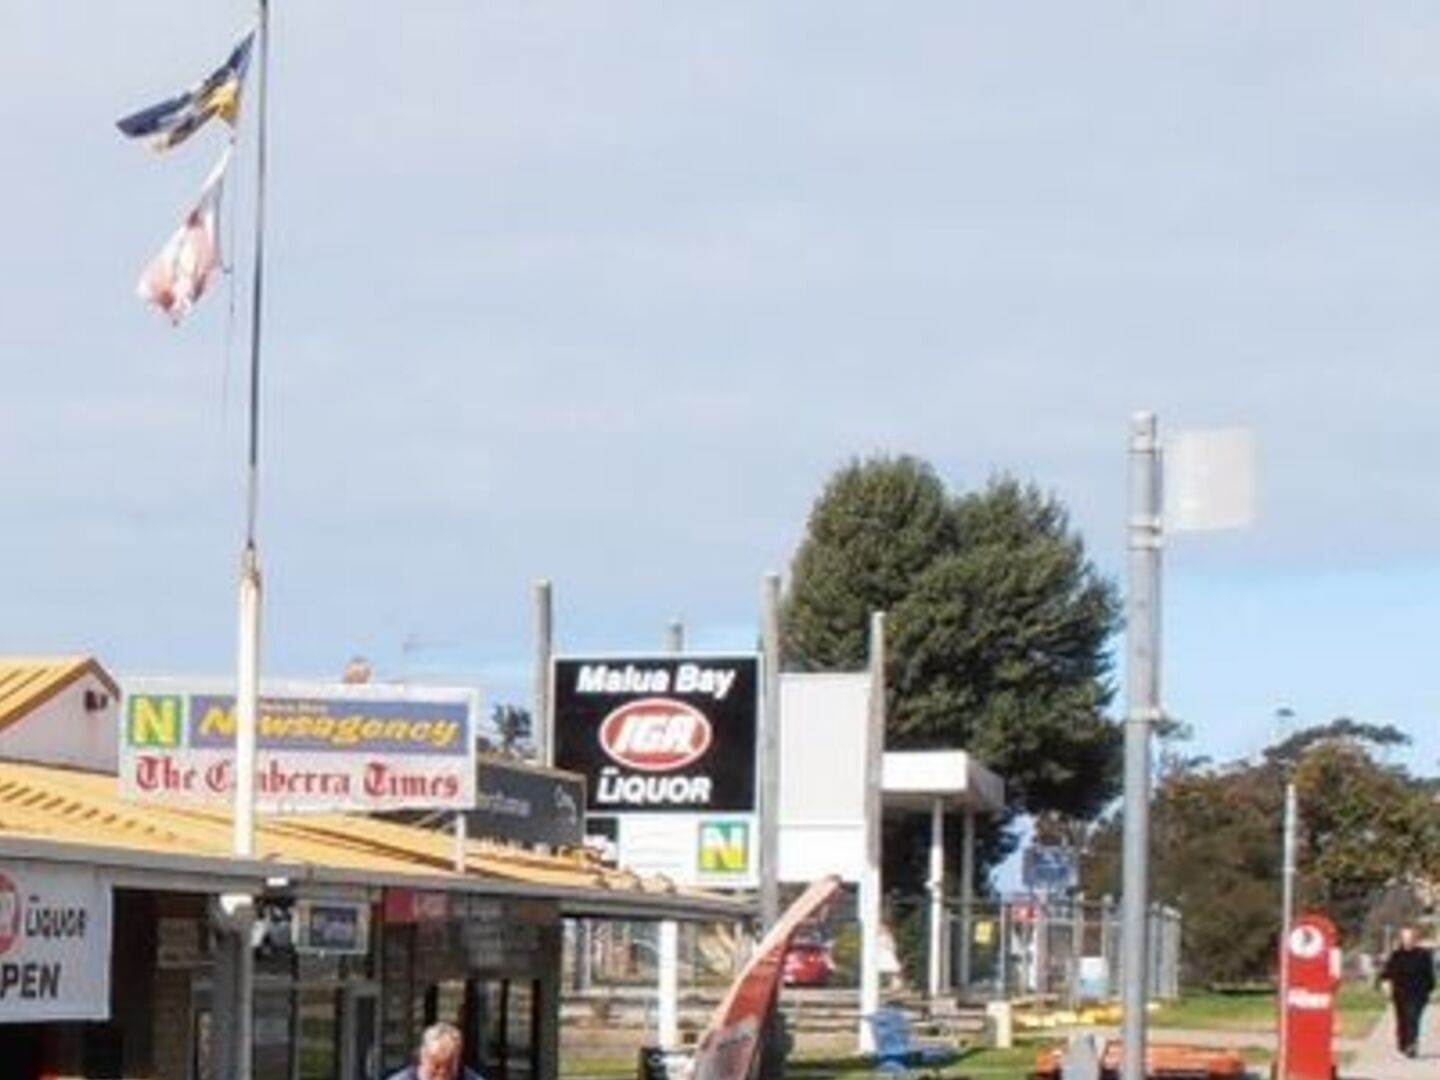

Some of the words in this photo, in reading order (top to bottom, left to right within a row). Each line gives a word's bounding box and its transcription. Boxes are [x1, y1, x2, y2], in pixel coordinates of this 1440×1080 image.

[675, 664, 736, 699] Bay
[132, 697, 177, 745] N
[199, 704, 459, 747] Nwsagency
[611, 714, 698, 754] IGA
[135, 755, 193, 792] The
[205, 758, 351, 796] Cberra
[363, 762, 459, 797] Times
[596, 774, 713, 804] LIQUOR
